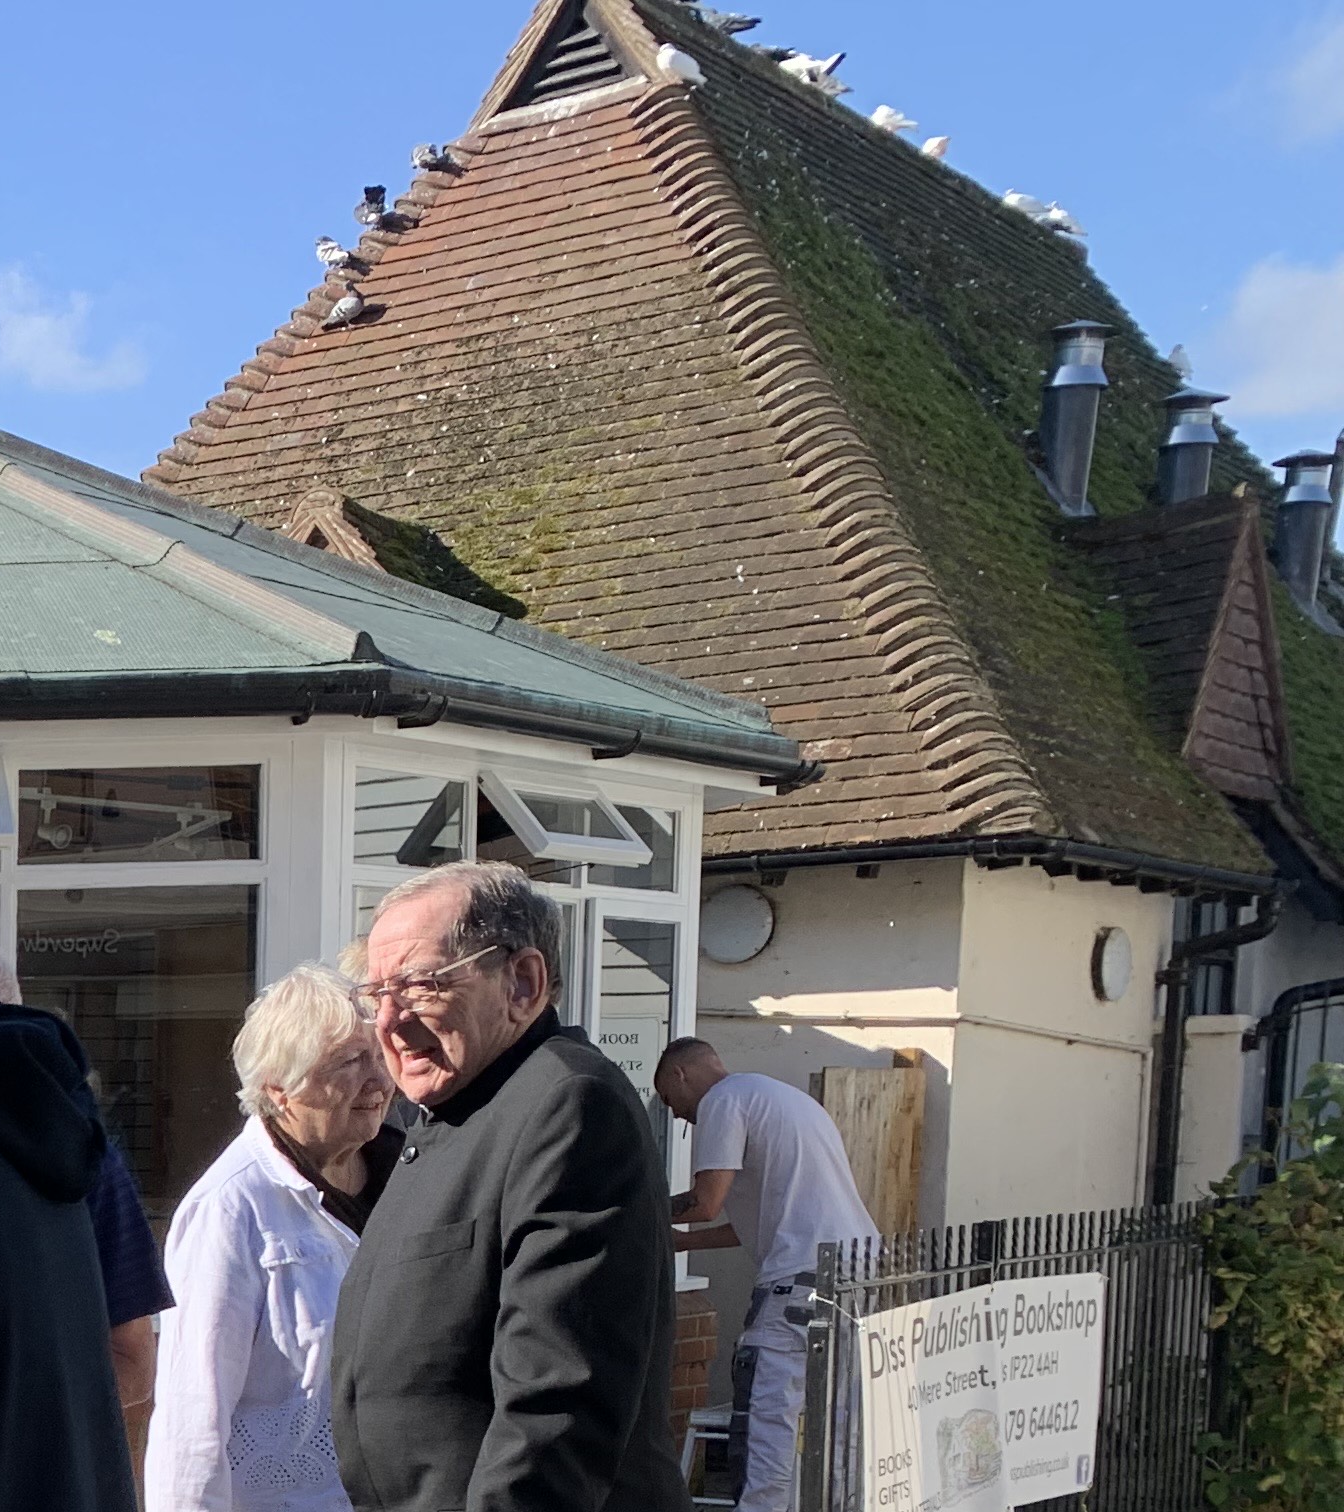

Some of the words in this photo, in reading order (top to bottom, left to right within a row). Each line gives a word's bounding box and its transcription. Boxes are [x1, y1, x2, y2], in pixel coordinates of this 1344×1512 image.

[868, 1328, 906, 1380] Diss
[1013, 1290, 1098, 1338] Bookshop
[918, 1380, 942, 1404] Mere
[945, 1364, 997, 1397] Street,
[1010, 1353, 1035, 1382] IP22
[1036, 1350, 1059, 1376] 4AH
[1030, 1399, 1080, 1439] 644612
[878, 1480, 910, 1506] GIFTS
